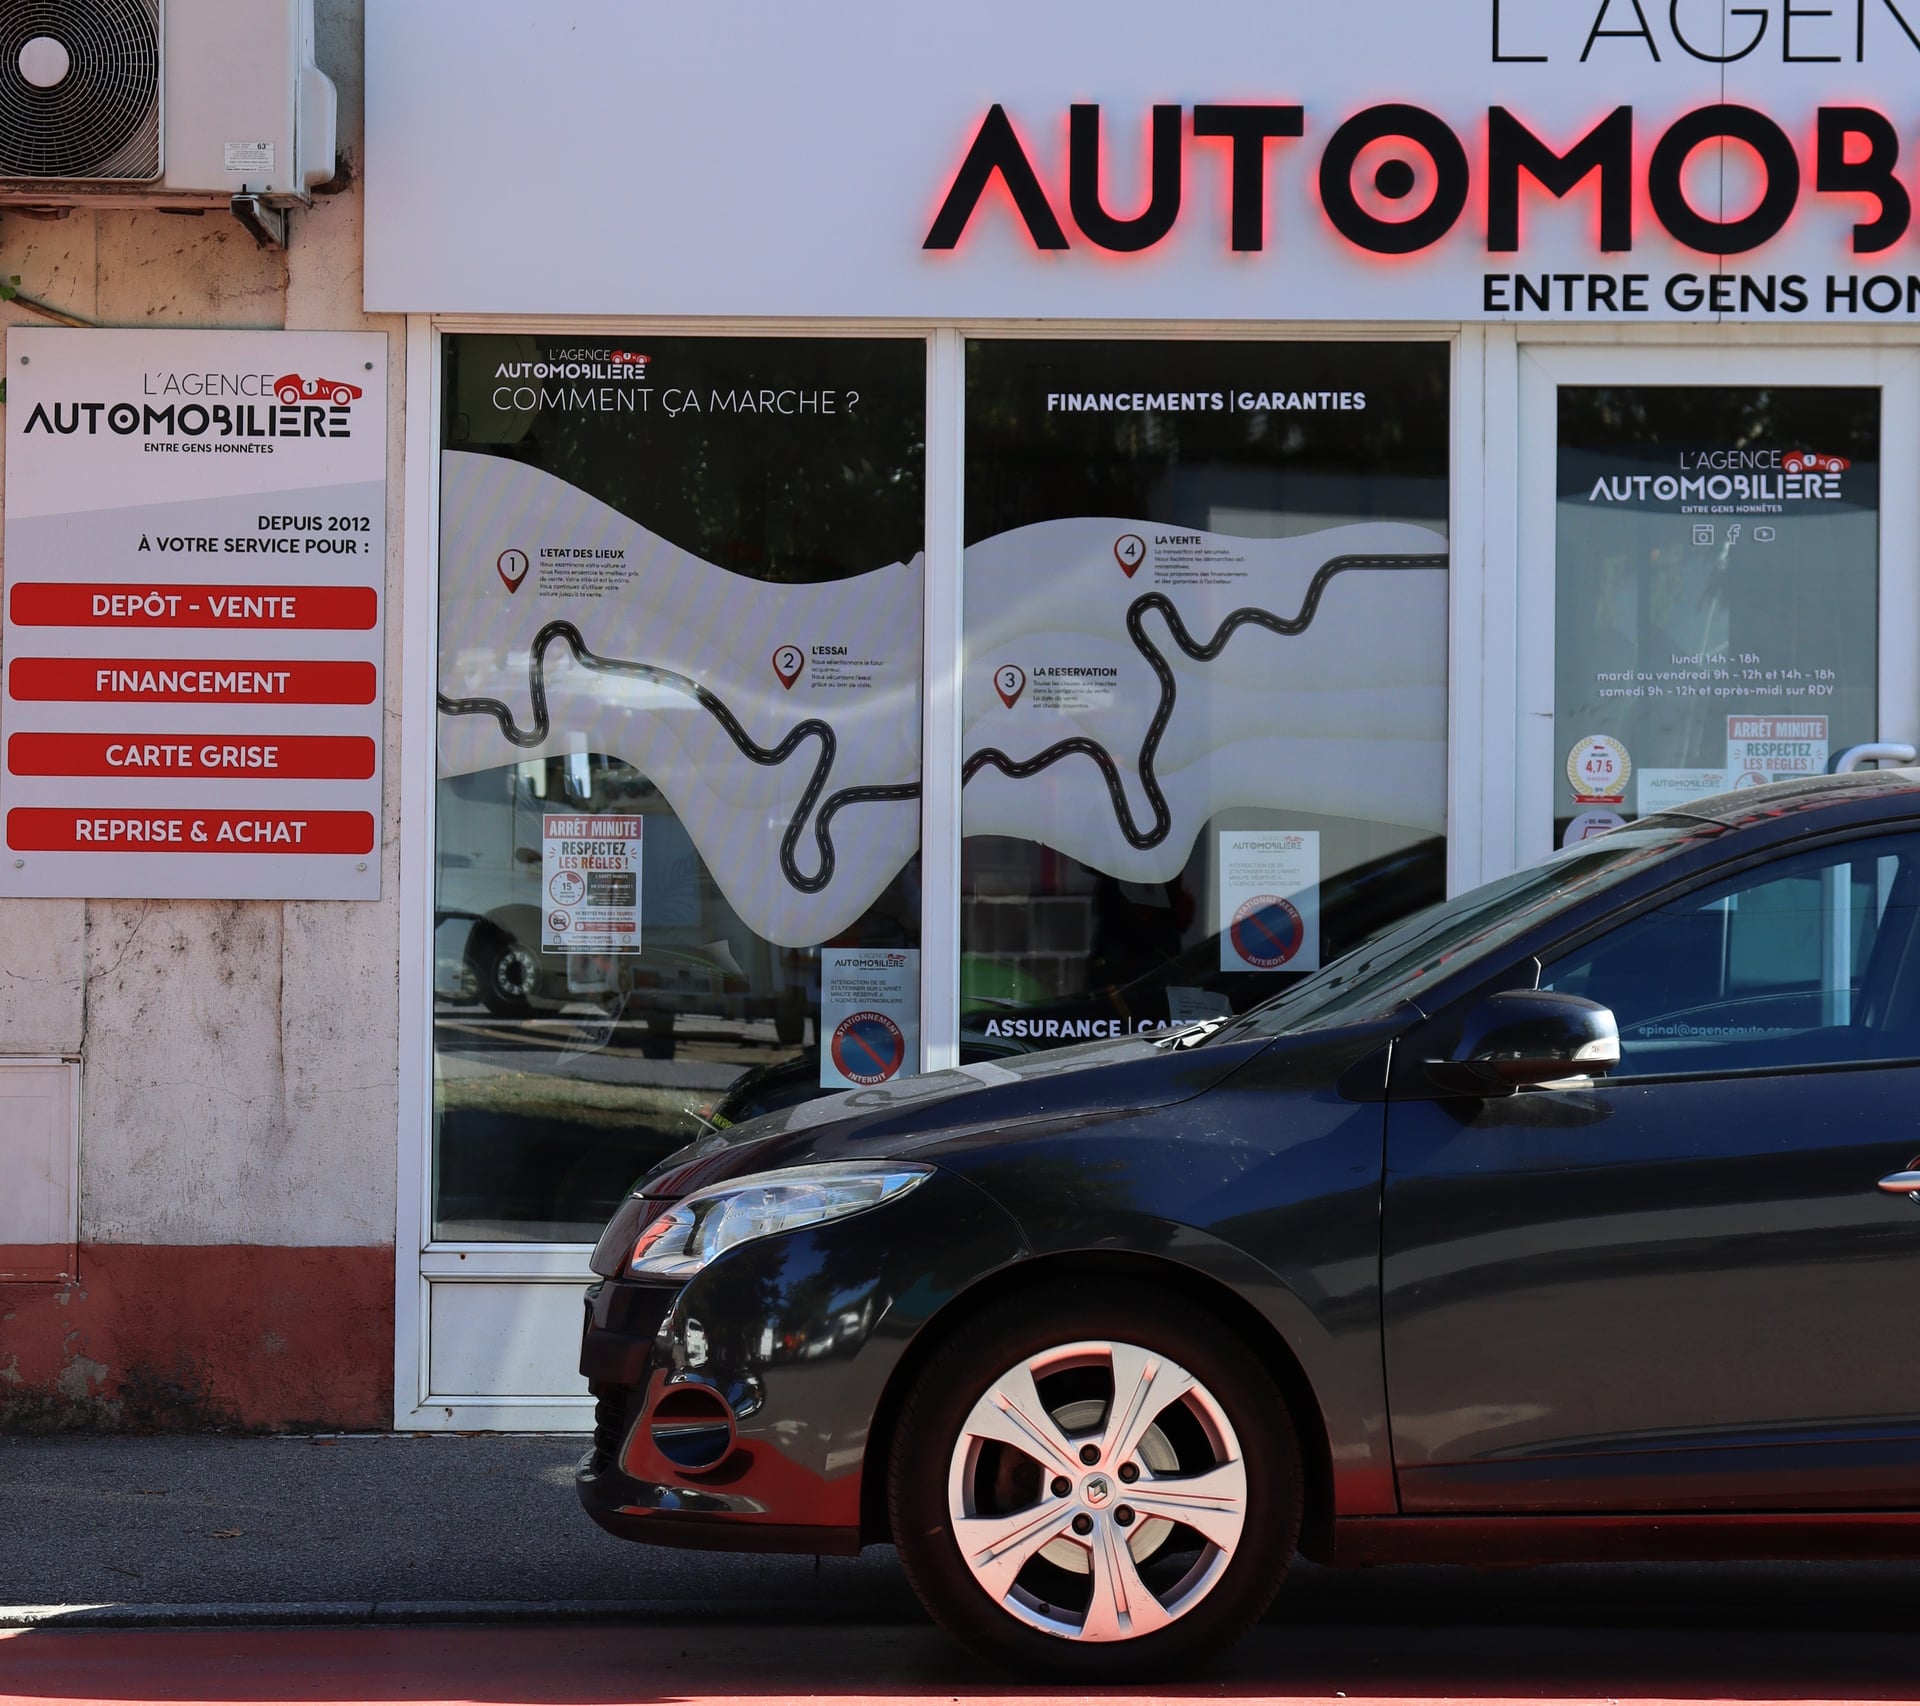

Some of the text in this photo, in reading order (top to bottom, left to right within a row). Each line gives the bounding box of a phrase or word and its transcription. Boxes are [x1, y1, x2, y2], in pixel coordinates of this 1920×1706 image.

[1483, 274, 1649, 311] ENTRE
[1665, 273, 1808, 312] GENS
[549, 349, 611, 361] L'AGENCE
[144, 373, 275, 397] L'AGENCE
[492, 387, 860, 417] COMMENT ÇA MARCHE ?
[1047, 392, 1224, 411] FINANCEMENTS
[1237, 392, 1367, 410] GARANTIES
[144, 442, 274, 454] ENTRE GENS HONNÊTES
[1680, 450, 1782, 469] L'AGENCE
[1737, 504, 1783, 512] HONNÊTES
[258, 516, 371, 532] DEPUIS 2012
[138, 534, 151, 551] À
[157, 537, 218, 552] VOTRE
[224, 538, 300, 553] SERVICE
[305, 539, 357, 554] POUR
[1155, 536, 1201, 545] LA VENTE
[540, 548, 624, 559] L'ETAT DES LIEUX
[1125, 542, 1136, 557] 4
[92, 591, 181, 617] DEPÔT
[208, 596, 296, 618] VENTE
[812, 646, 848, 655] L'ESSAI
[784, 653, 794, 668] 2
[1672, 653, 1703, 664] lundi
[1705, 653, 1726, 664] 14h
[1739, 653, 1760, 664] 18h
[1033, 667, 1117, 677] LA RESERVATION
[1597, 670, 1634, 681] mardi
[1638, 673, 1652, 681] au
[1655, 669, 1710, 680] vendredi
[1713, 669, 1729, 680] 9h
[1742, 669, 1762, 680] 12h
[1765, 670, 1777, 680] et
[1780, 669, 1801, 680] 14h
[1814, 669, 1835, 680] 18h
[96, 670, 290, 694] FINANCEMENT
[1004, 672, 1016, 688] 3
[1599, 686, 1644, 697] samedi
[1647, 686, 1663, 696] 9h
[1676, 685, 1695, 696] 12h
[1699, 685, 1710, 696] et
[1714, 684, 1782, 698] après-midi
[1786, 687, 1806, 696] sur
[1808, 685, 1833, 696] RDV
[1733, 720, 1823, 738] ARRÊT MINUTE
[106, 744, 278, 768] CARTE GRISE
[1746, 743, 1811, 757] RESPECTEZ
[1744, 758, 1764, 770] LES
[1766, 756, 1807, 771] RÈGLES
[75, 819, 307, 843] REPRISE & ACHAT
[549, 818, 638, 837] ARRÊT MINUTE
[562, 841, 626, 856] RESPECTEZ
[559, 857, 578, 869] LES
[581, 854, 622, 870] RÈGLES
[562, 883, 572, 891] 15
[1247, 955, 1286, 967] INTERDIT
[836, 1013, 899, 1037] STATIONNEMENT
[984, 1018, 1122, 1038] ASSURANCE
[1138, 1019, 1200, 1033] CA
[848, 1072, 887, 1084] INTERDIT
